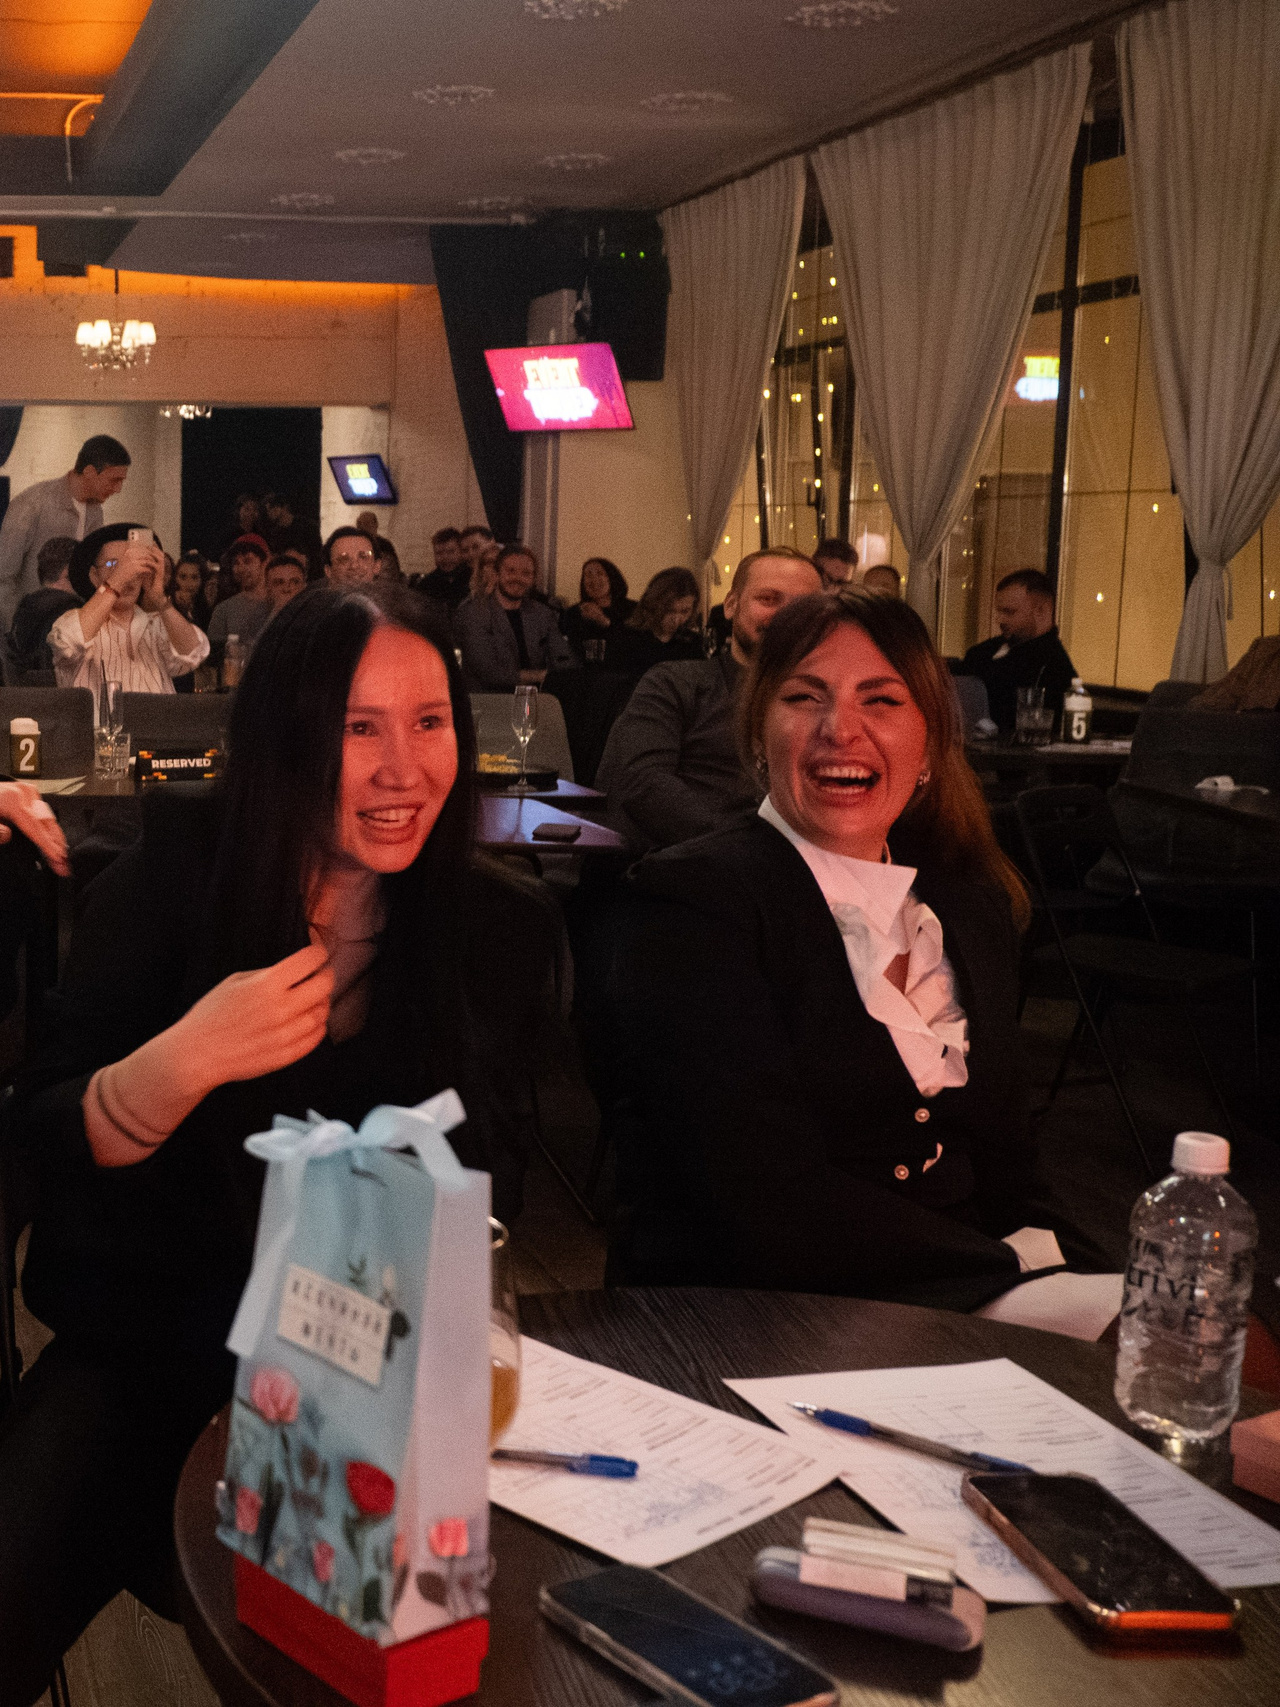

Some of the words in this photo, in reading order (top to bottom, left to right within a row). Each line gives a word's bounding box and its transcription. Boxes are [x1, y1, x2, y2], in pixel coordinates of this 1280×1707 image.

[1072, 712, 1087, 740] 5
[19, 737, 36, 772] 2
[151, 757, 213, 770] RESERVED
